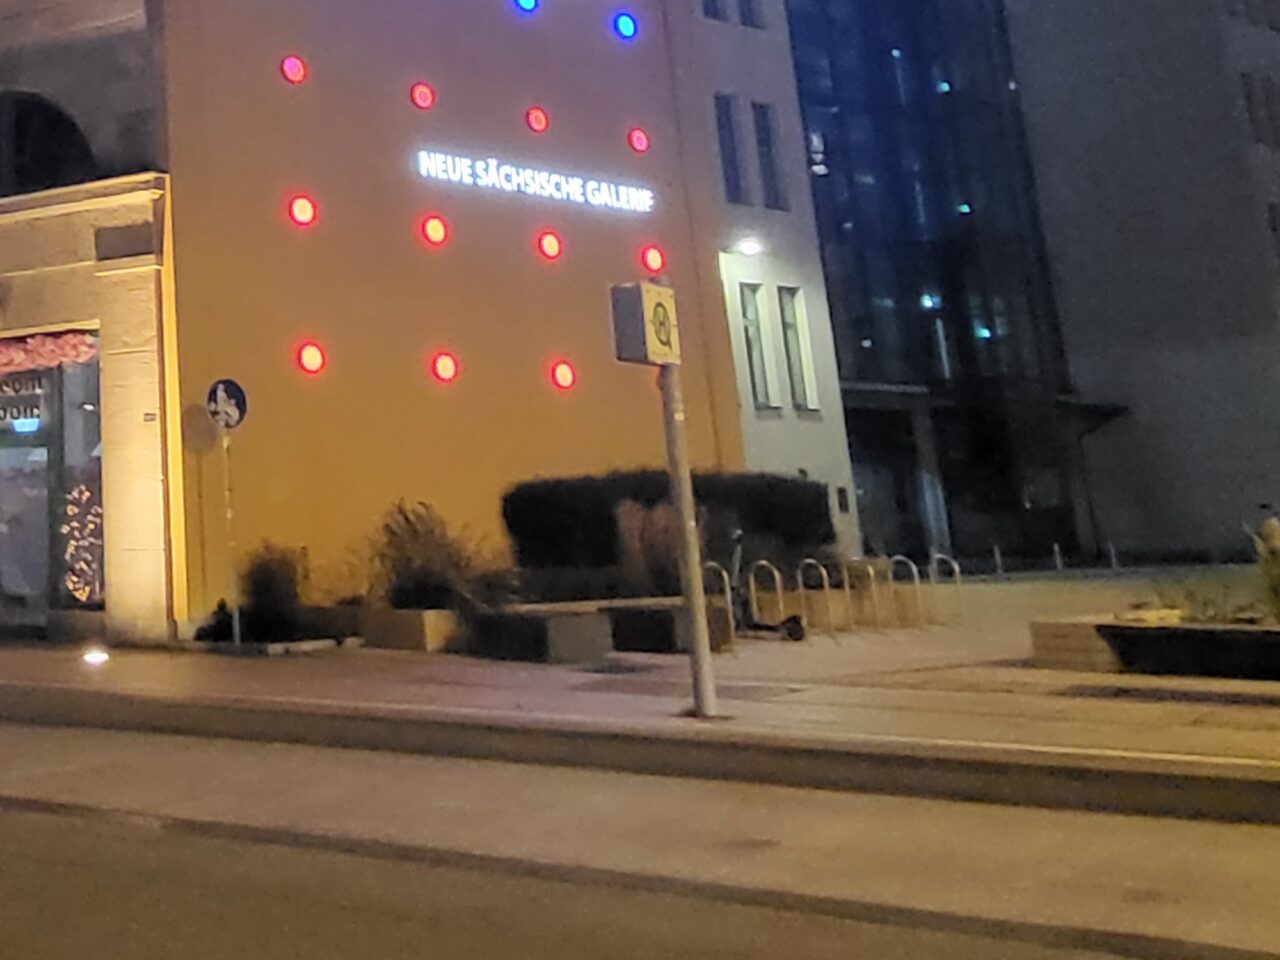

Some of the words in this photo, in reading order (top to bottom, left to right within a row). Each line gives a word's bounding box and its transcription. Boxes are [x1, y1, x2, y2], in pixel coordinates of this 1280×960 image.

[418, 150, 472, 184] NEUE
[475, 158, 584, 203] SÄCHSISCHE
[586, 180, 654, 212] GALERIE
